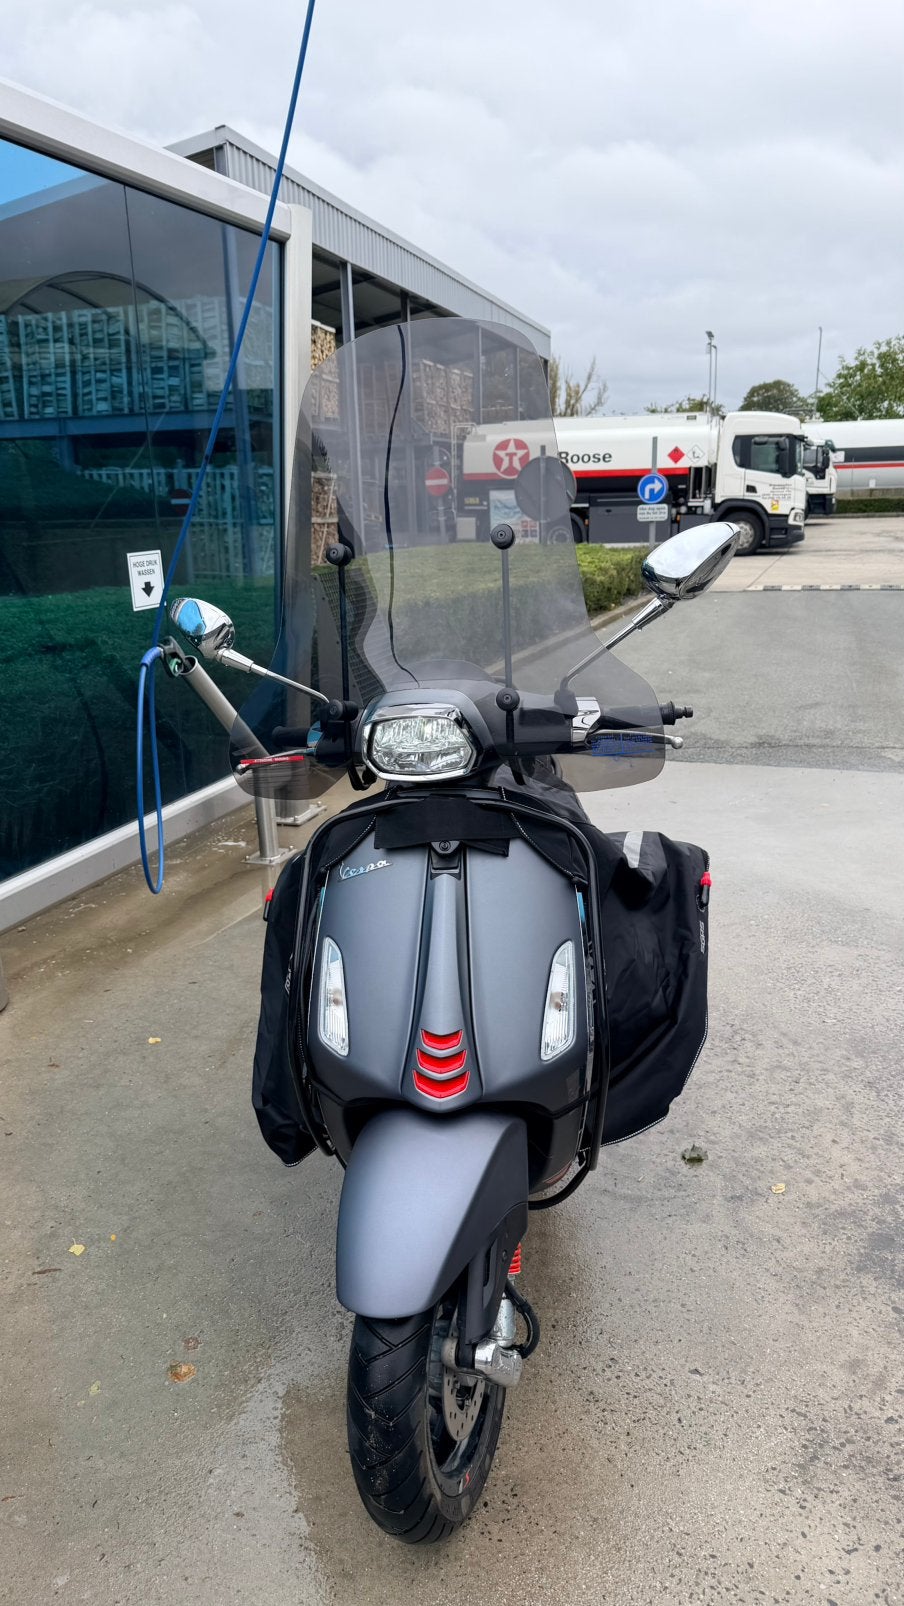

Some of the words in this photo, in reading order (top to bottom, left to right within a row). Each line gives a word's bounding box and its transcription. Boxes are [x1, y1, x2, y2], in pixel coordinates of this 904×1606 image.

[558, 451, 613, 464] Roose
[133, 560, 145, 568] HOGE
[137, 568, 156, 576] WASSEN
[339, 860, 392, 880] Vespa
